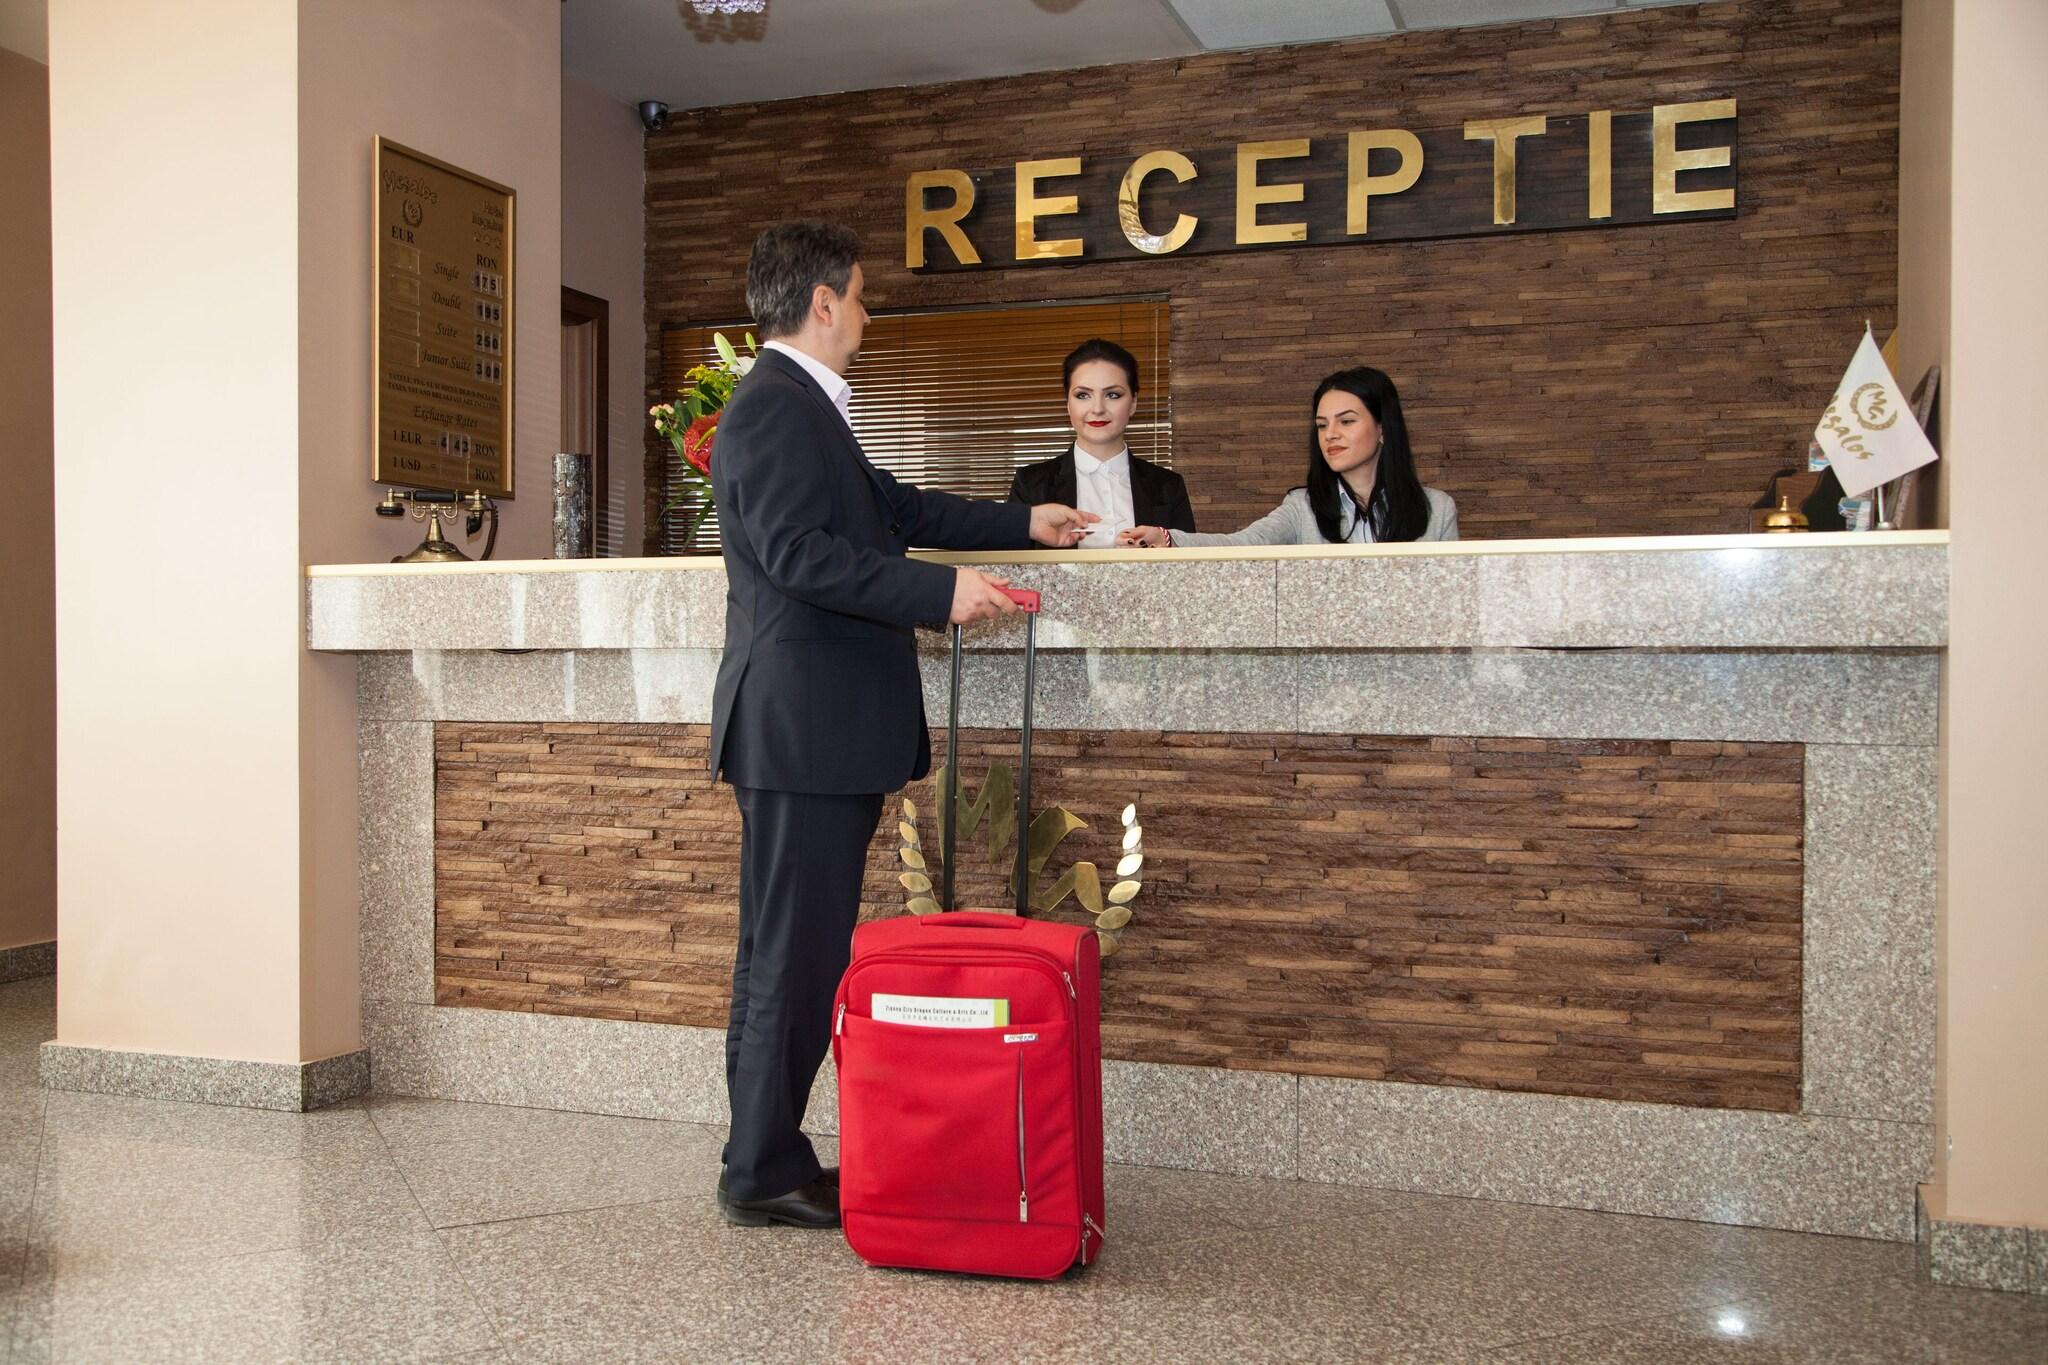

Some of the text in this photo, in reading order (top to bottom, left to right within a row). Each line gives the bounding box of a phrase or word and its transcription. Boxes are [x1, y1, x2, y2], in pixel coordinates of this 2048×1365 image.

[905, 98, 1738, 271] RECEPTIE
[392, 225, 415, 244] EUR
[476, 254, 498, 271] RON
[433, 262, 497, 291] Single 175
[432, 289, 461, 310] Double
[435, 322, 499, 350] Suite 250
[421, 349, 500, 379] Junior Suite 300
[414, 405, 479, 428] Exchange Rates
[400, 430, 422, 446] EUR
[475, 443, 497, 457] RON
[400, 458, 421, 472] USD
[475, 468, 497, 481] RON
